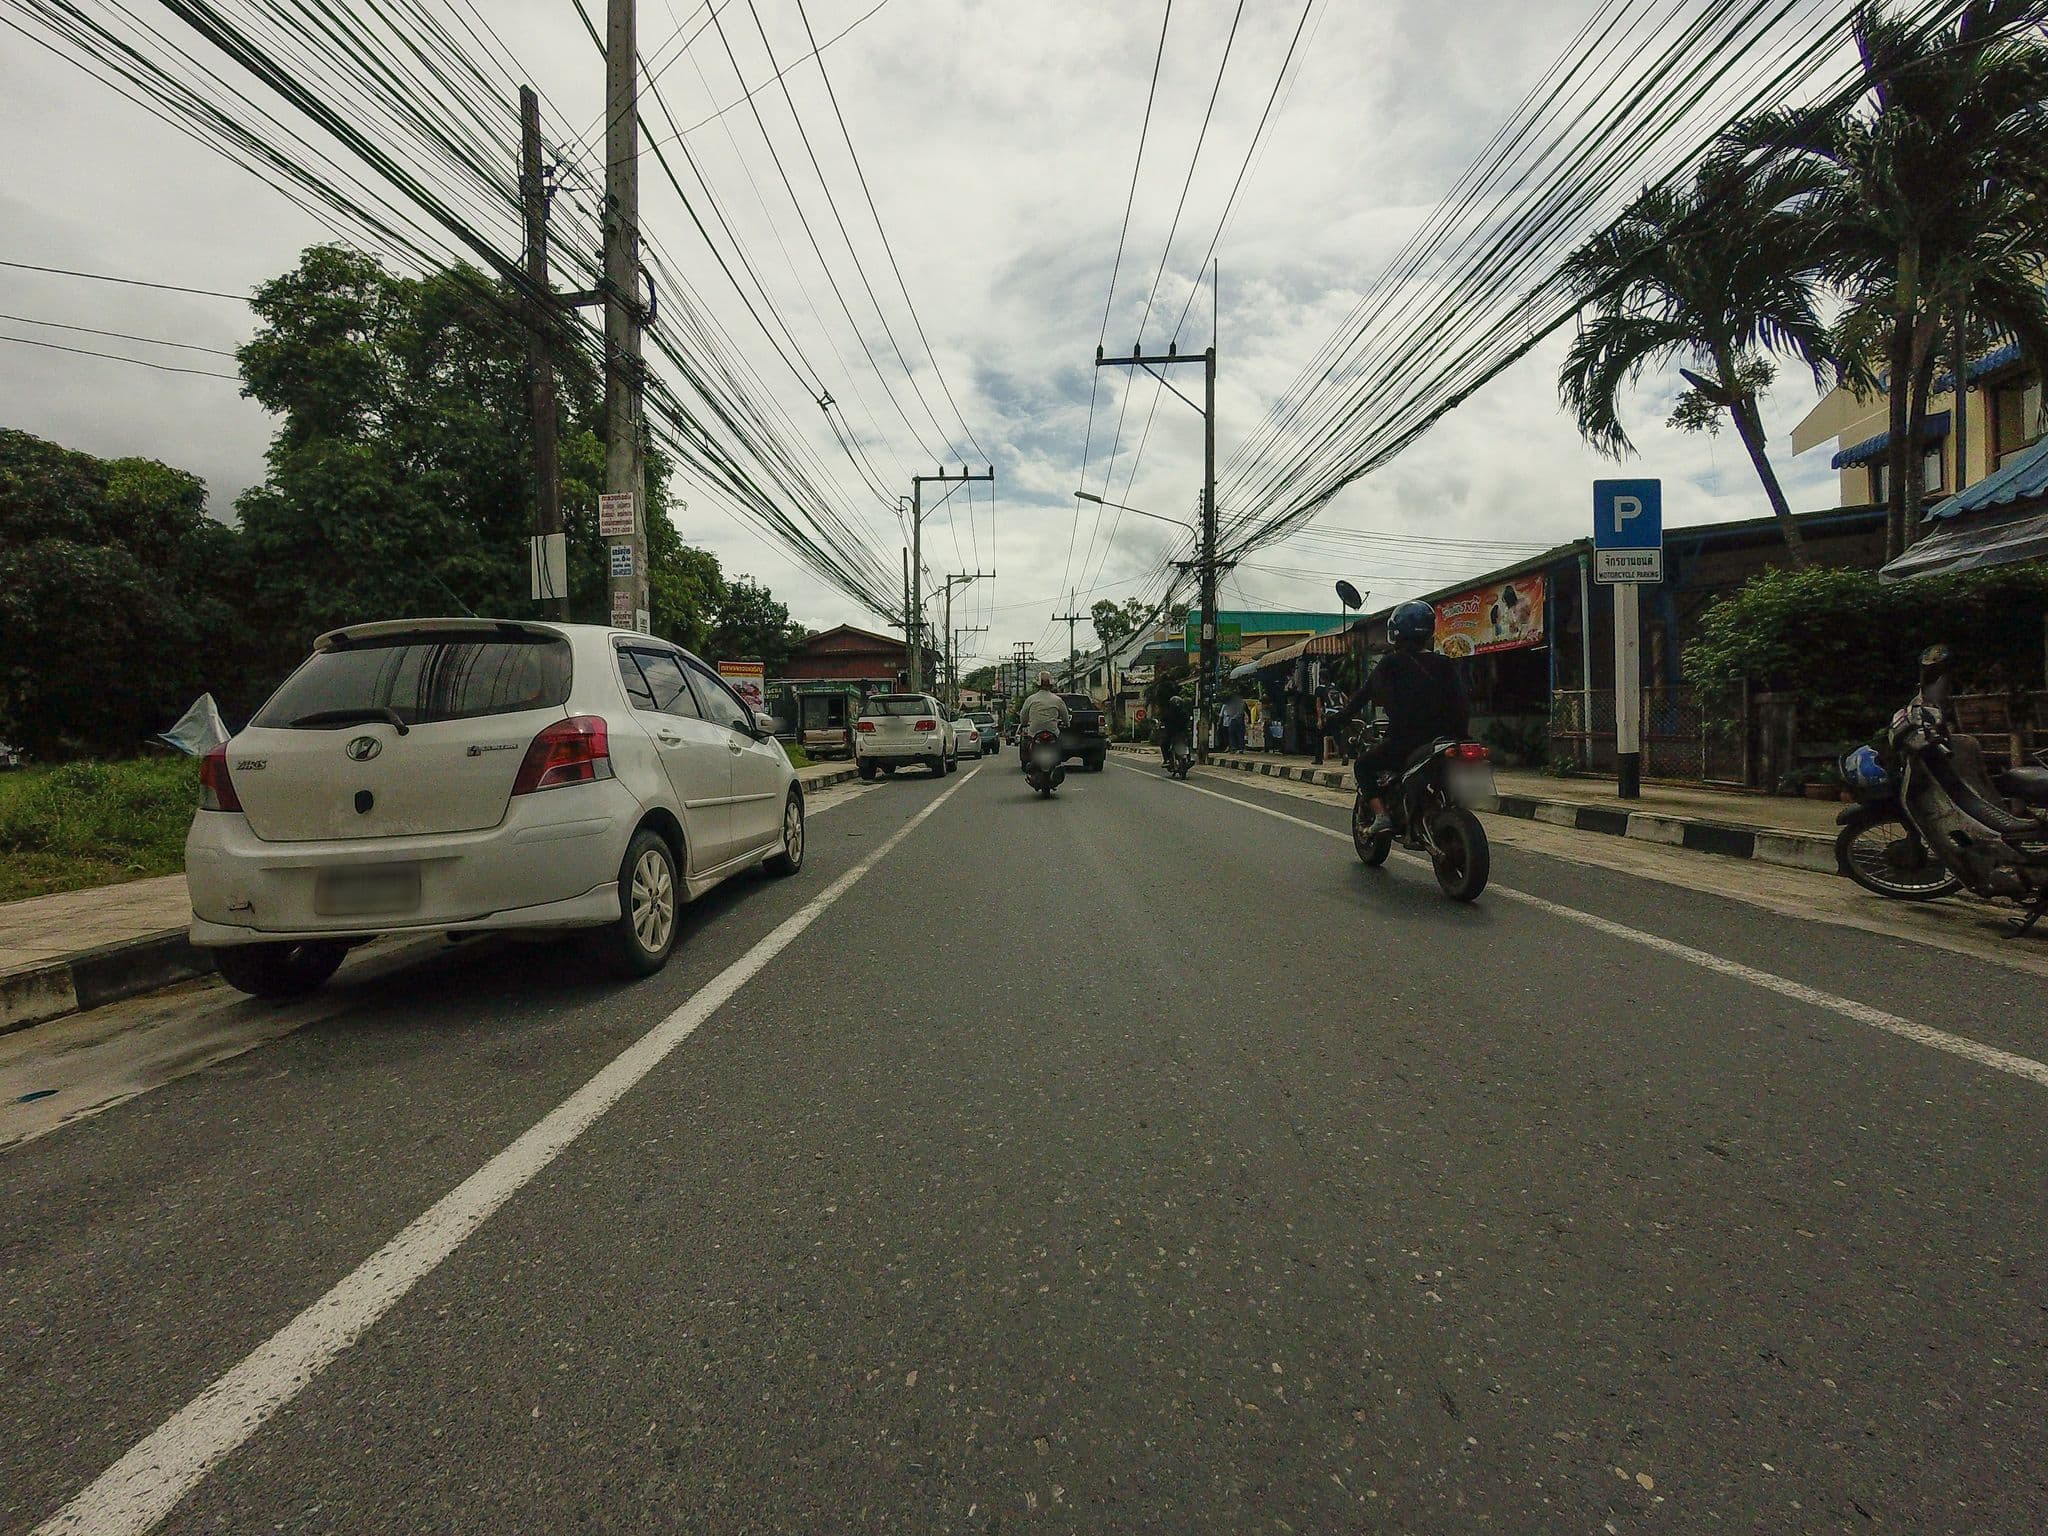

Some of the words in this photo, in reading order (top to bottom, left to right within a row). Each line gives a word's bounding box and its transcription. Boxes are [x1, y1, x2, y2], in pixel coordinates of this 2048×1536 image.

[1614, 495, 1643, 533] P
[1605, 553, 1653, 566] จักรยานยนต์
[1636, 570, 1659, 578] PARKING
